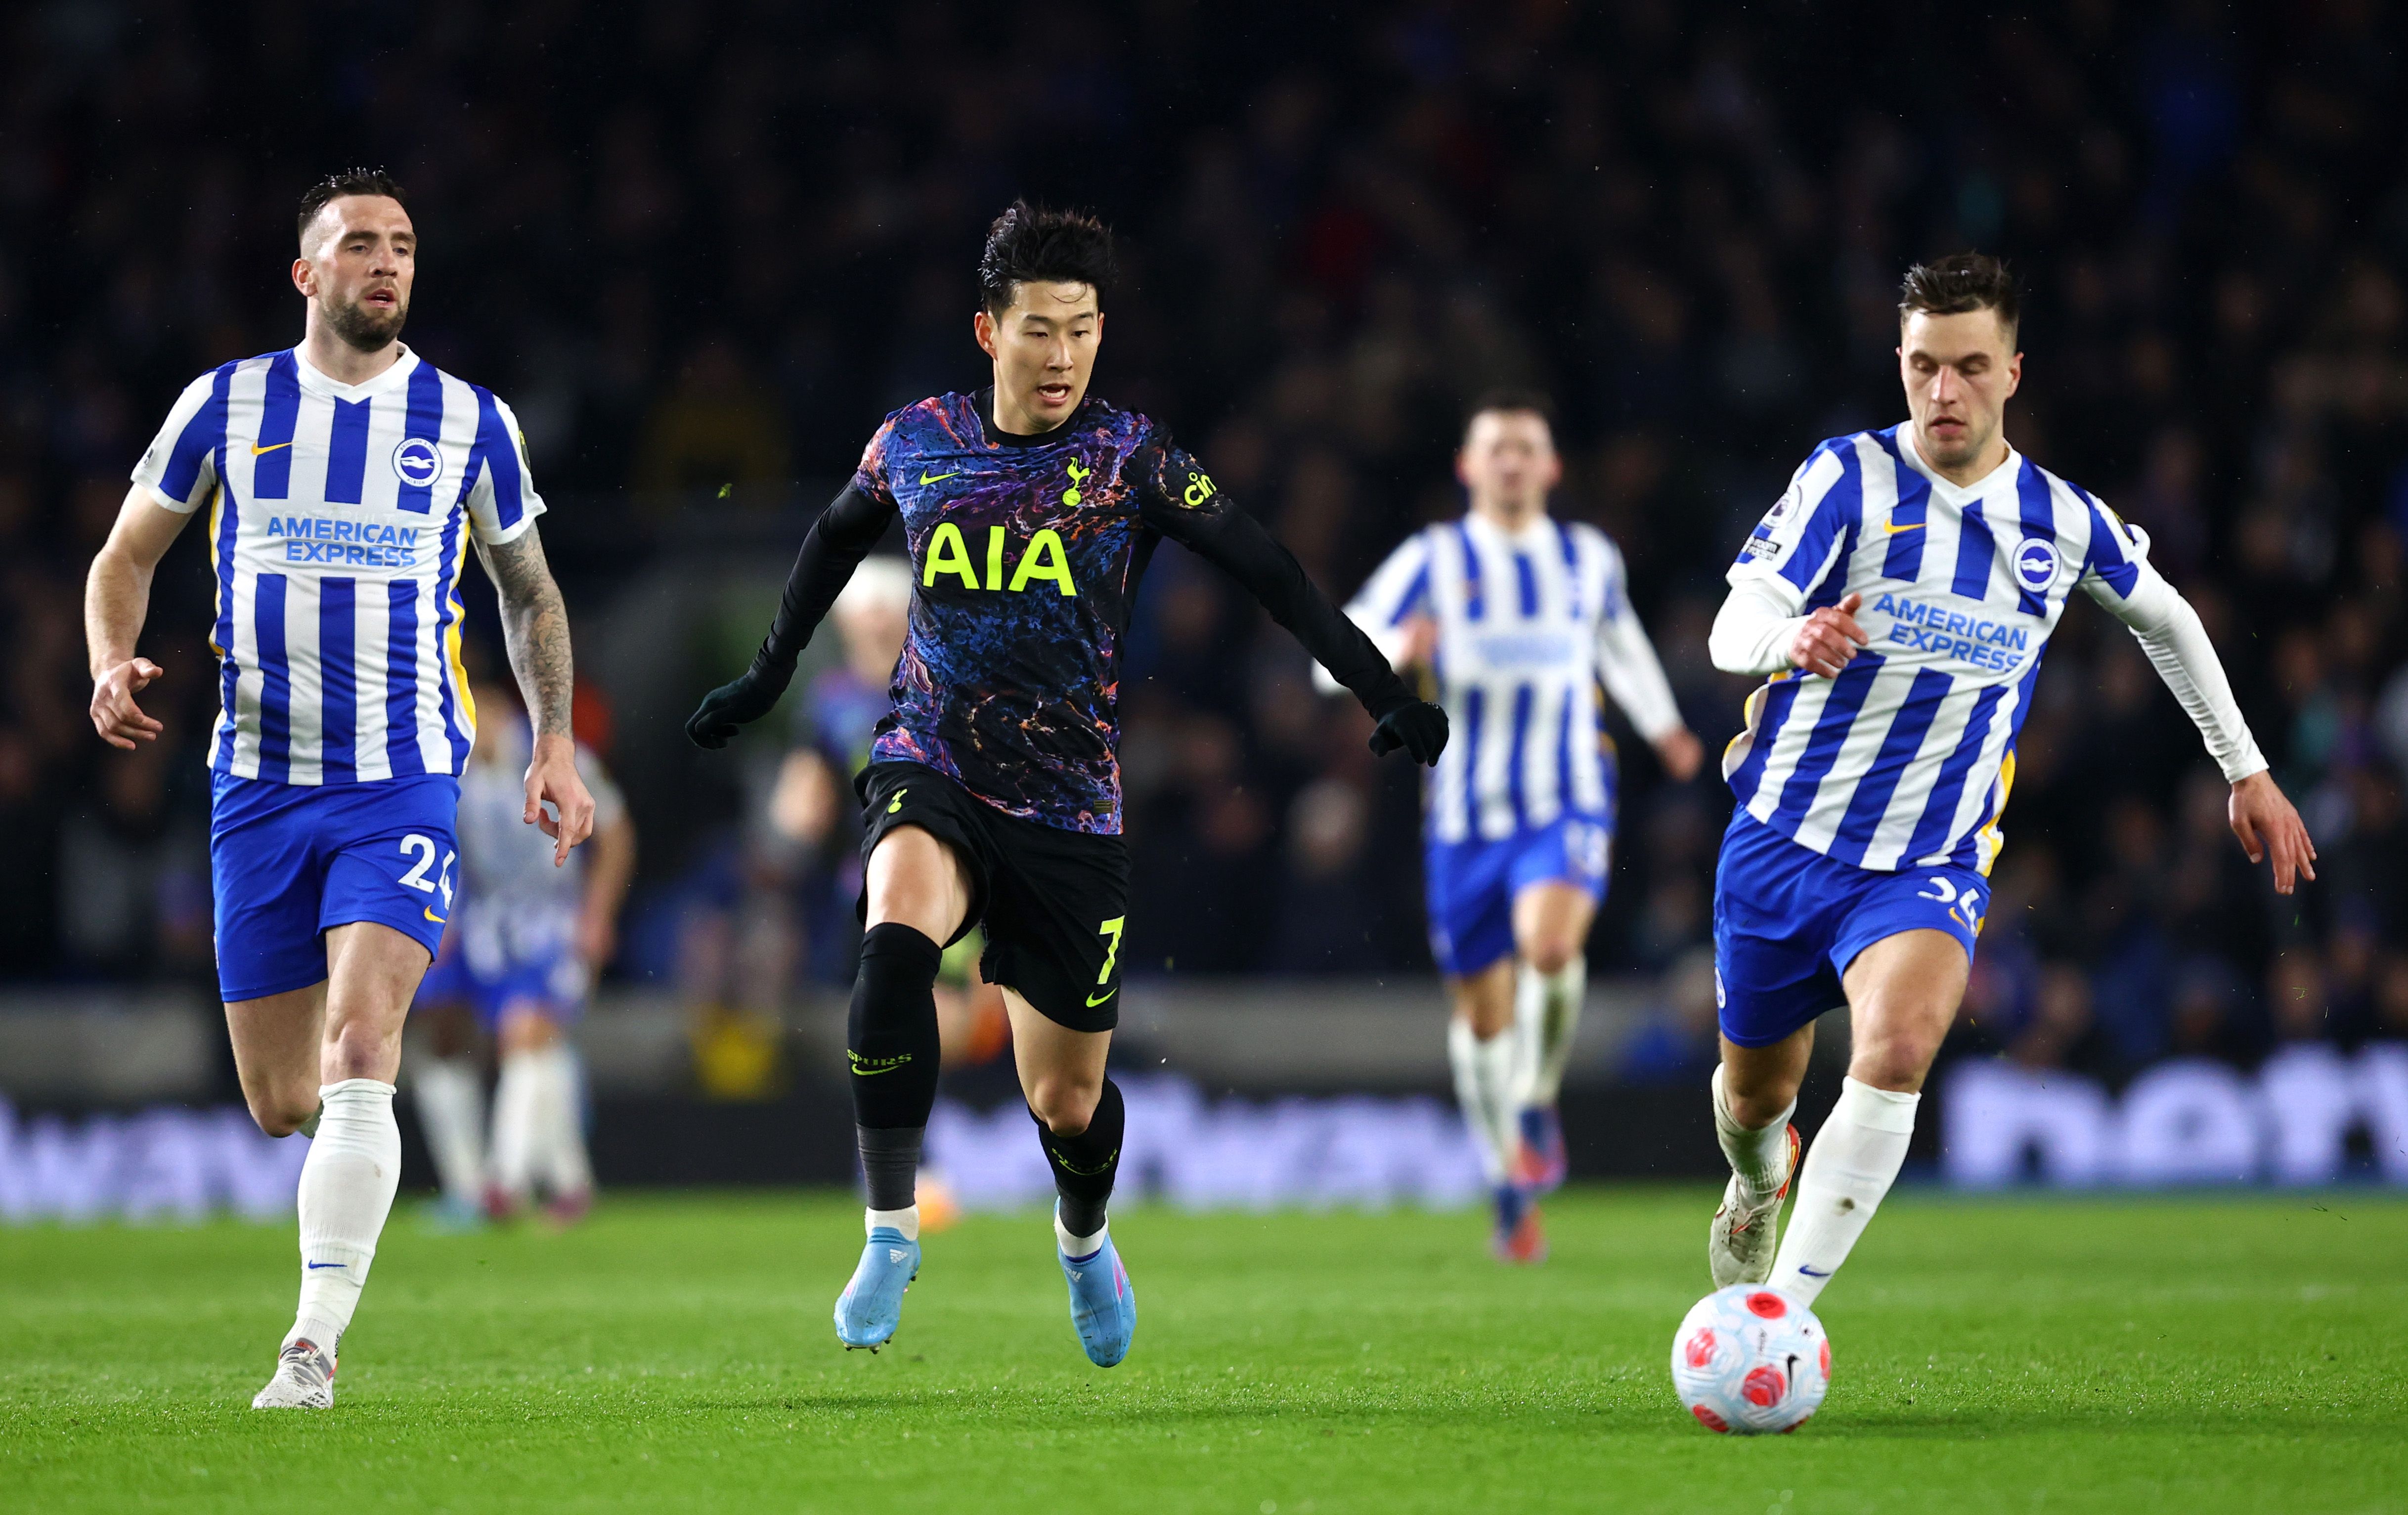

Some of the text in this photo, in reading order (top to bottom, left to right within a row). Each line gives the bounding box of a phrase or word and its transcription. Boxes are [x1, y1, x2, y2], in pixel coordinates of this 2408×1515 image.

[267, 517, 419, 547] AMERICAN
[286, 540, 416, 566] EXPRESS
[923, 522, 1077, 596] AIA
[1873, 593, 2027, 651] AMERICAN
[1888, 622, 2025, 673] EXPRESS
[397, 833, 456, 911] 24
[1096, 914, 1125, 985] 7
[846, 1048, 912, 1066] SPURS
